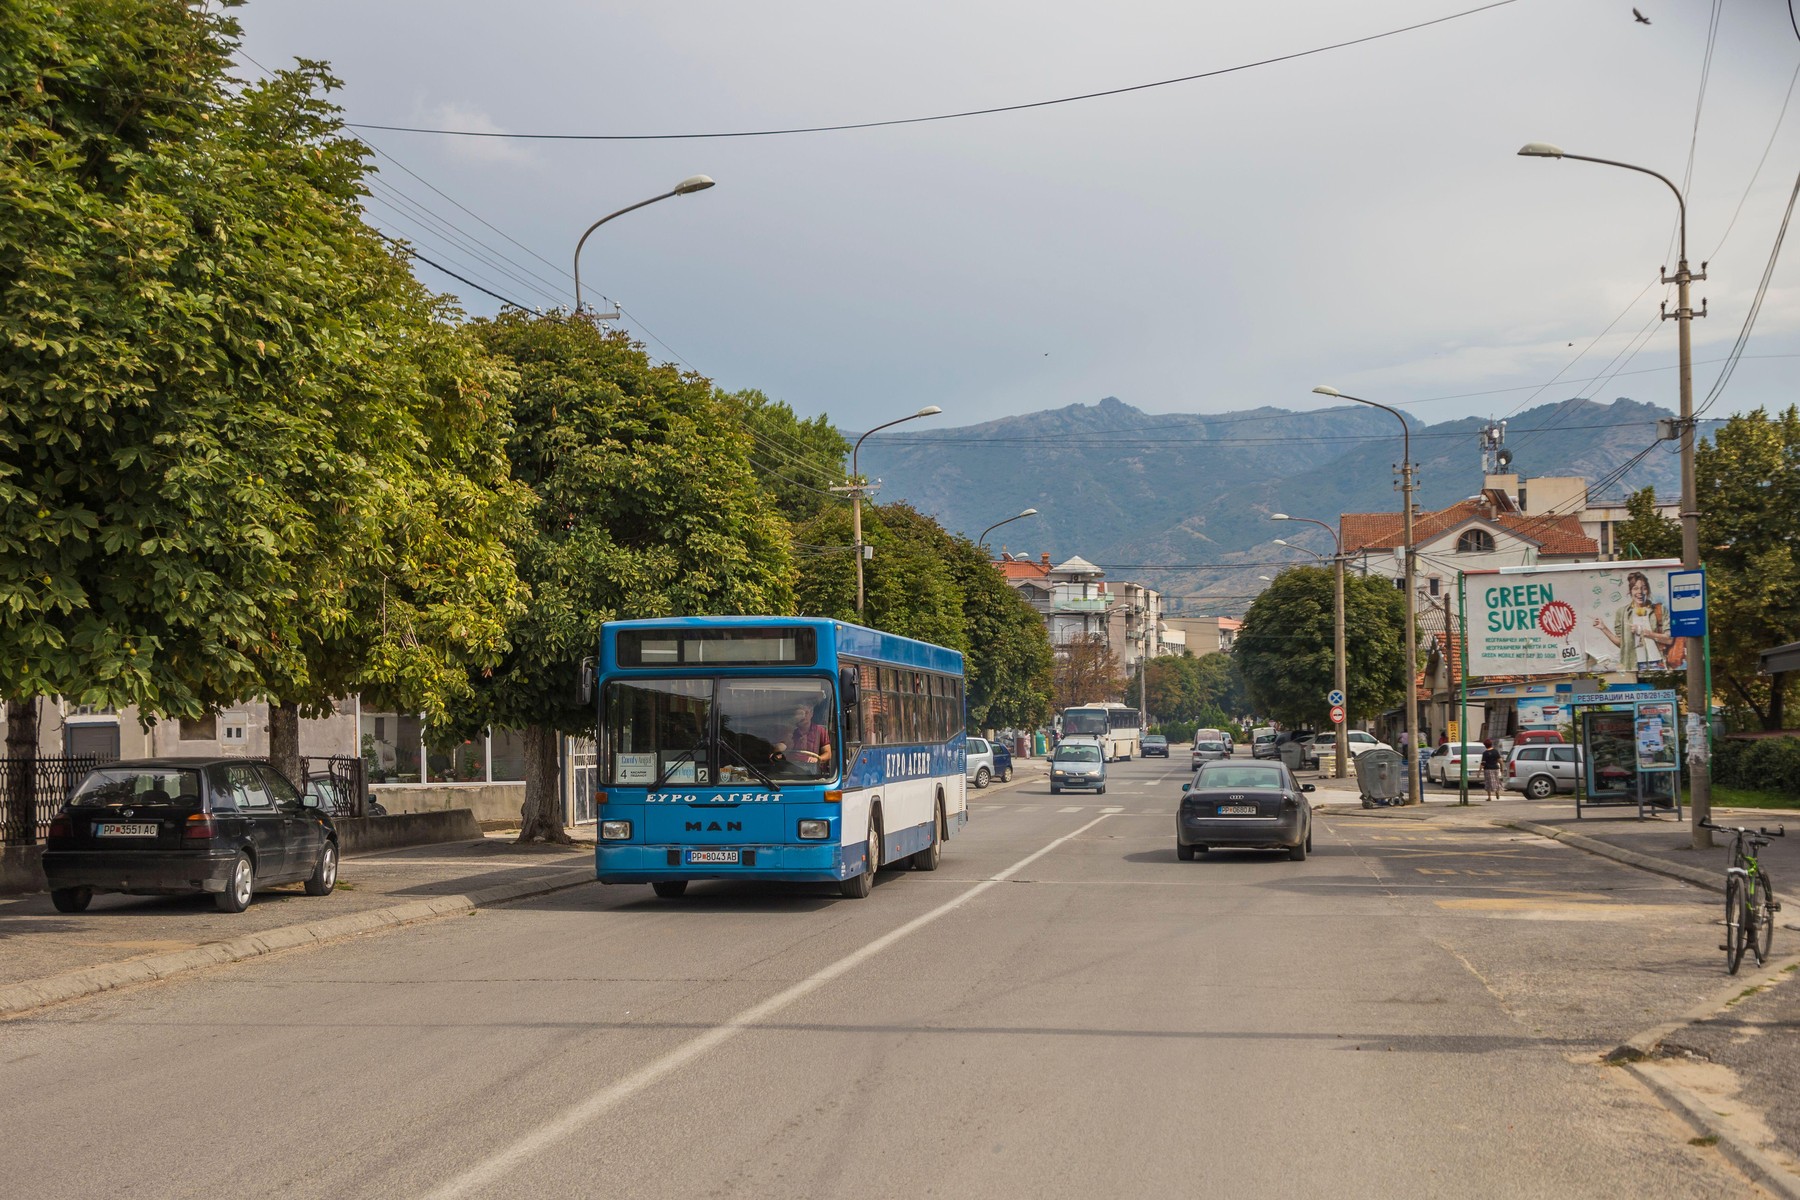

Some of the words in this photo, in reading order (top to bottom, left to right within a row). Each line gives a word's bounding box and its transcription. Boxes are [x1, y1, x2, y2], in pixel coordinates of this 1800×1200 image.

[1485, 583, 1554, 609] GREEN
[1487, 608, 1540, 633] SURF
[1542, 605, 1573, 632] PROMO
[1577, 694, 1624, 702] РЕЗЕРВАЦИИ
[886, 753, 906, 778] ЕУРО
[908, 752, 930, 775] АГЕНТ
[620, 769, 627, 780] 4
[699, 770, 707, 782] 2
[645, 793, 697, 802] ЕУРО
[710, 793, 784, 802] АГЕНТ
[685, 821, 742, 832] MAN
